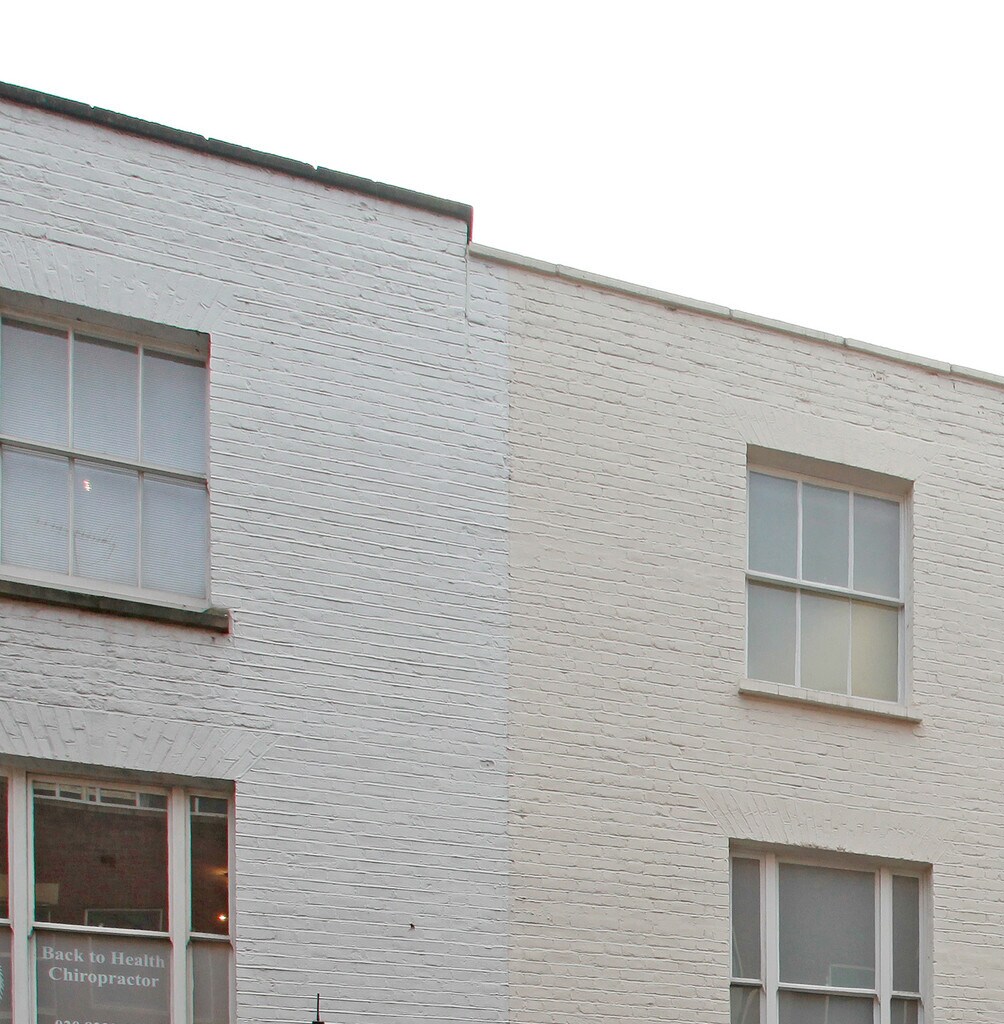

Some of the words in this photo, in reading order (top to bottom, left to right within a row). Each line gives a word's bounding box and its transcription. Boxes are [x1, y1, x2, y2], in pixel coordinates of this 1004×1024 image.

[41, 946, 84, 962] Back
[89, 952, 105, 964] to
[111, 951, 165, 968] Health
[48, 967, 159, 987] Chiropractor
